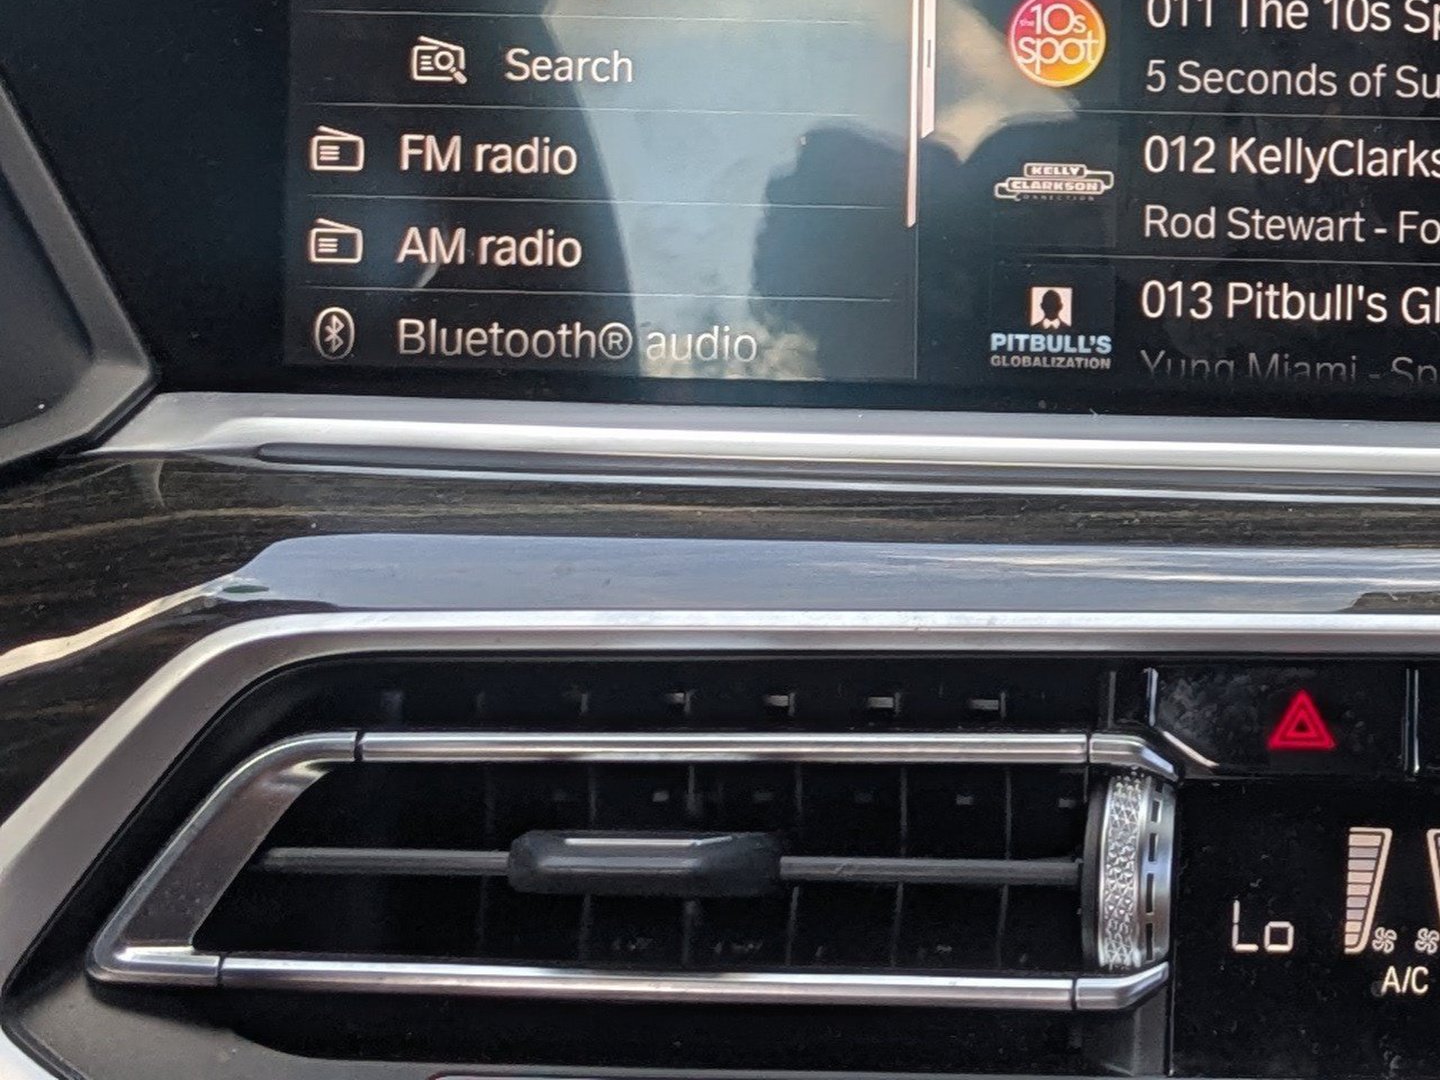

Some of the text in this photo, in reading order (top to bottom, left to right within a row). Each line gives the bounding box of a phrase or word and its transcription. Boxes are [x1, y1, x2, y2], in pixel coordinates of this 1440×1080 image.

[1030, 3, 1088, 36] 10s
[505, 48, 634, 84] Search
[1015, 29, 1099, 75] spot
[1145, 59, 1167, 93] 5
[1178, 60, 1339, 98] Seconds
[1348, 64, 1388, 98] of
[399, 133, 578, 176] FM radio
[1030, 165, 1081, 176] KELLY
[1144, 135, 1217, 174] 012
[1010, 180, 1098, 192] CLARKSON
[1143, 204, 1216, 239] Rod
[1226, 206, 1366, 243] Stewart
[396, 227, 583, 268] AM radio
[1141, 280, 1214, 320] 013
[1227, 282, 1388, 322] Pitbull's
[398, 319, 759, 364] Bluetooth® audio
[990, 333, 1112, 355] PITBULL'S
[990, 355, 1111, 370] GLOBALIZATION
[1231, 900, 1294, 953] Lo
[1381, 965, 1430, 996] A/C
